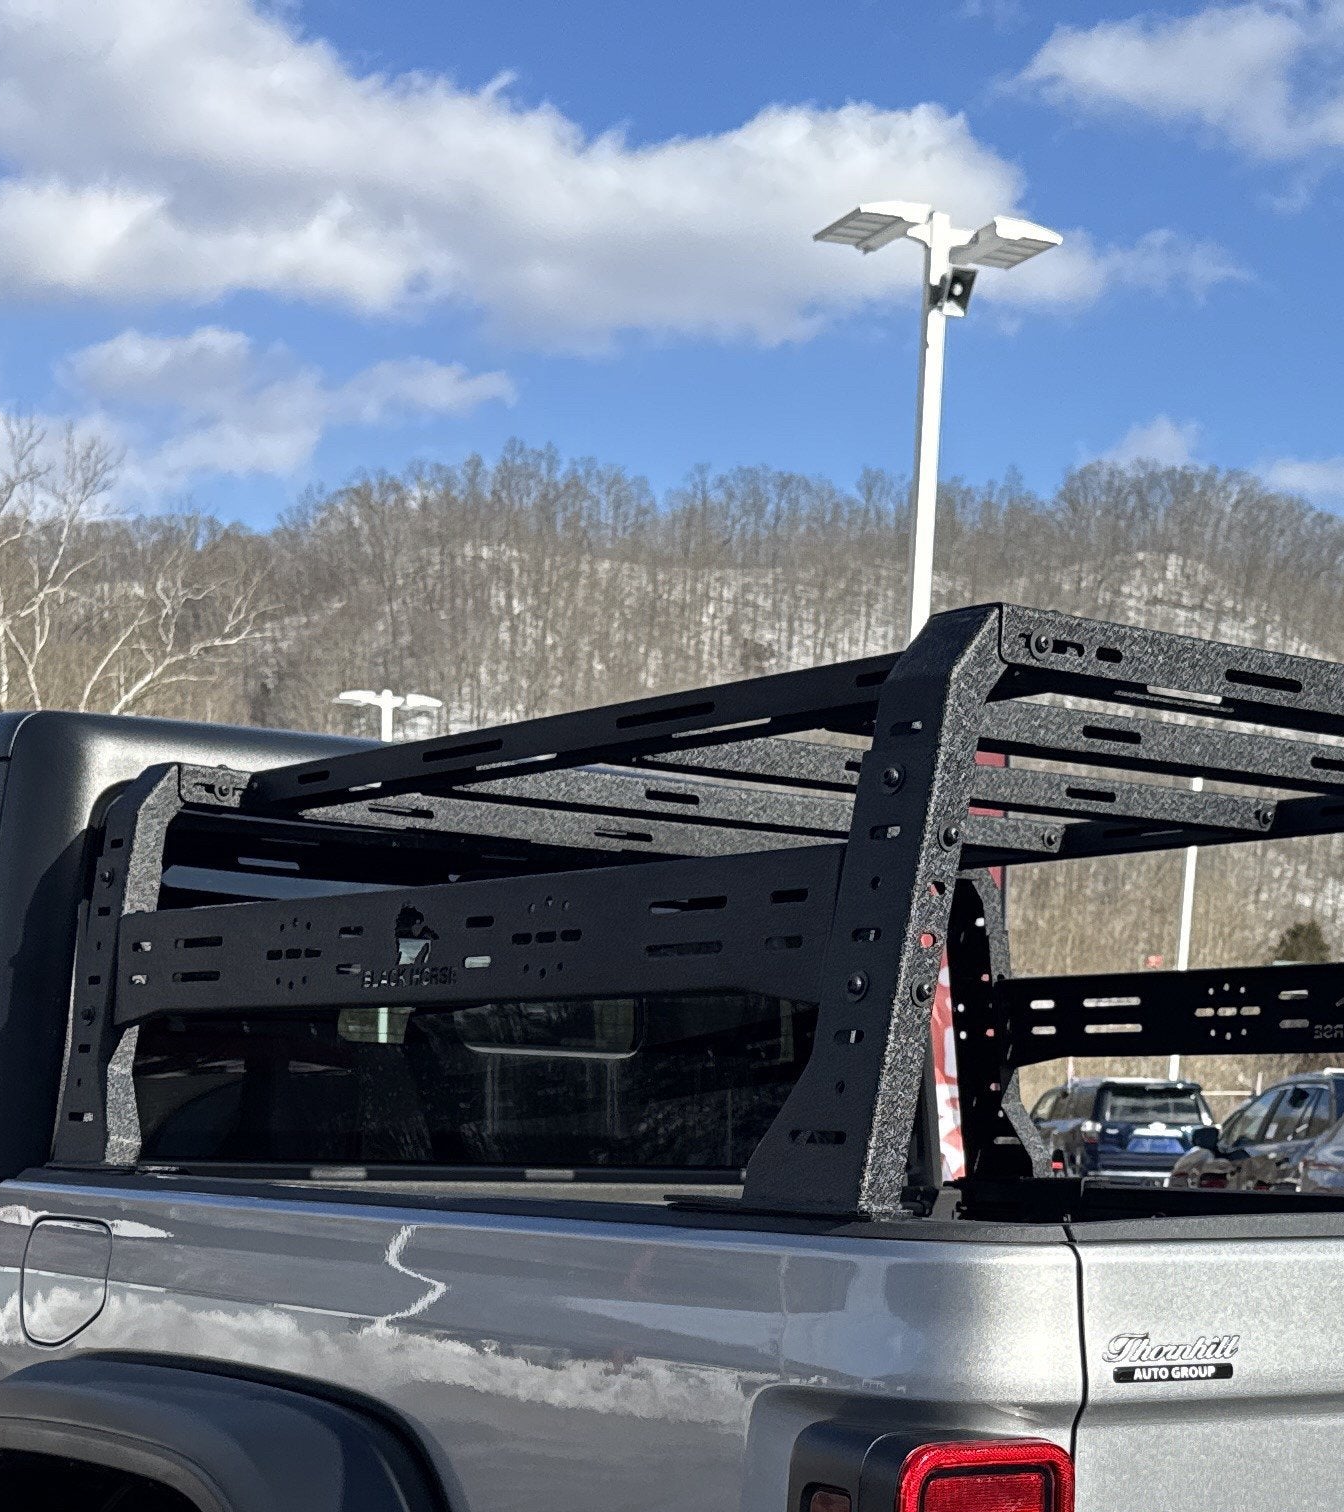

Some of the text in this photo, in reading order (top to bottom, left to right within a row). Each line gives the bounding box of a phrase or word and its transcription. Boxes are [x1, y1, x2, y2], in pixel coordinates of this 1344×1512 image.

[361, 967, 407, 988] BLACK
[1102, 1332, 1240, 1362] Thornhill
[1133, 1365, 1216, 1380] AUTO GROUP
